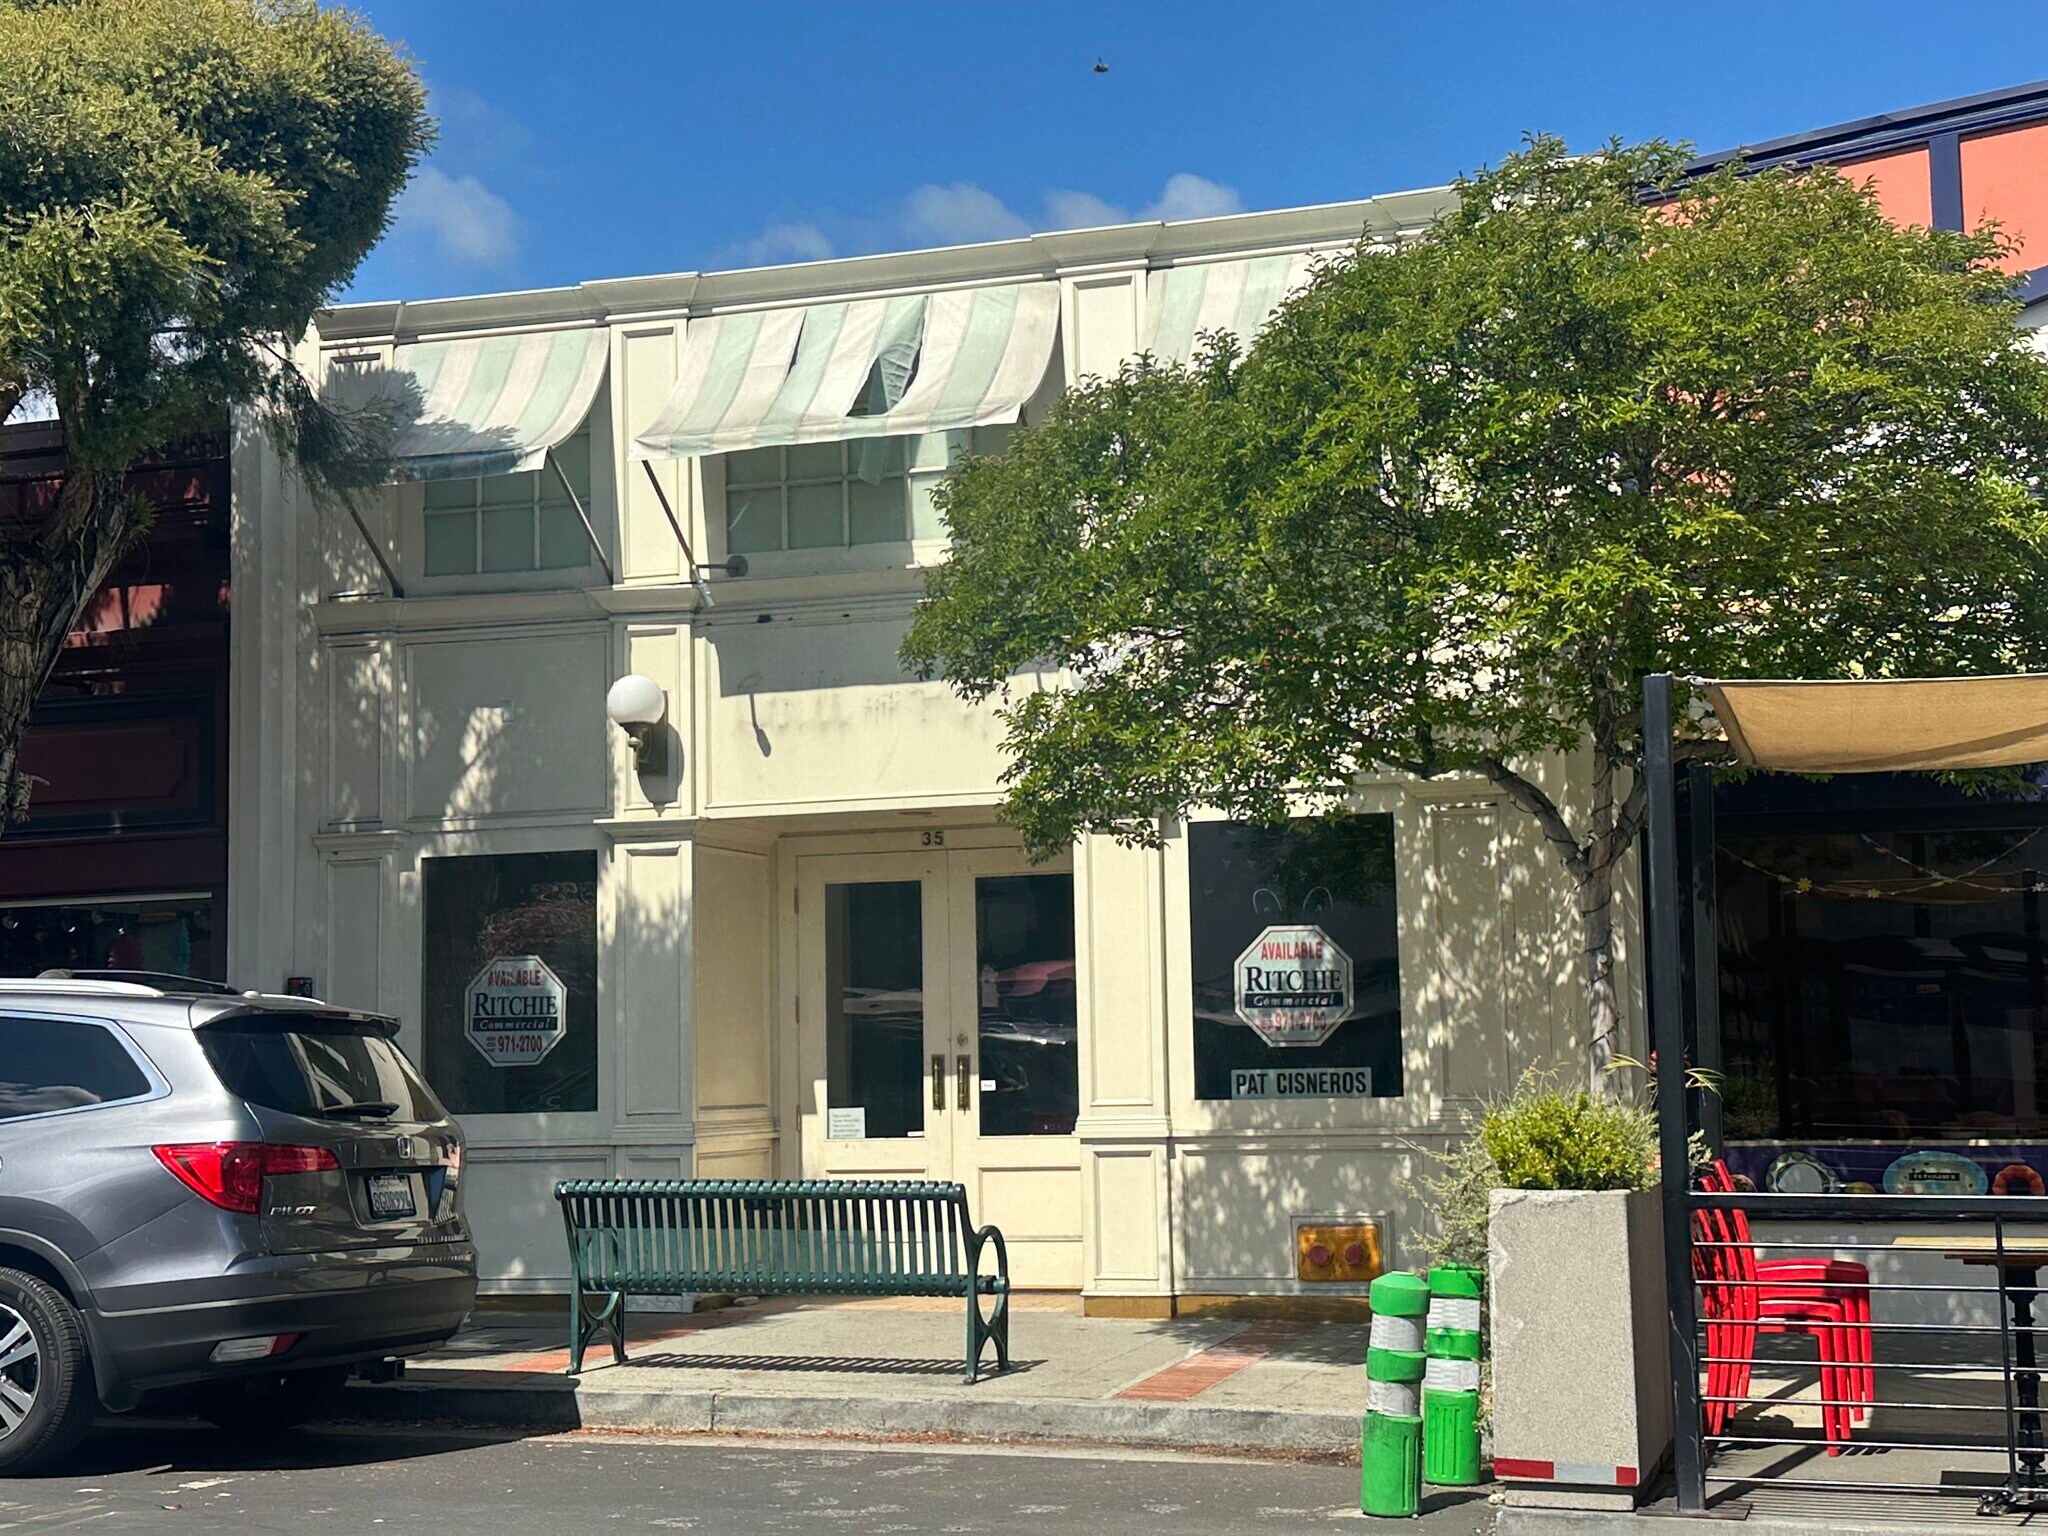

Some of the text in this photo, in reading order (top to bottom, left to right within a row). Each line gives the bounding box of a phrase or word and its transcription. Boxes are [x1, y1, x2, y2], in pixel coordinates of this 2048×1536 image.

[922, 831, 944, 846] 35
[1261, 941, 1323, 960] AVAILABLE
[487, 970, 541, 987] AVAILABLE
[1253, 995, 1335, 1006] Commercial
[480, 1018, 550, 1030] Commercial
[1236, 1071, 1367, 1095] PAT CISNEROS
[270, 1205, 317, 1215] PILOT
